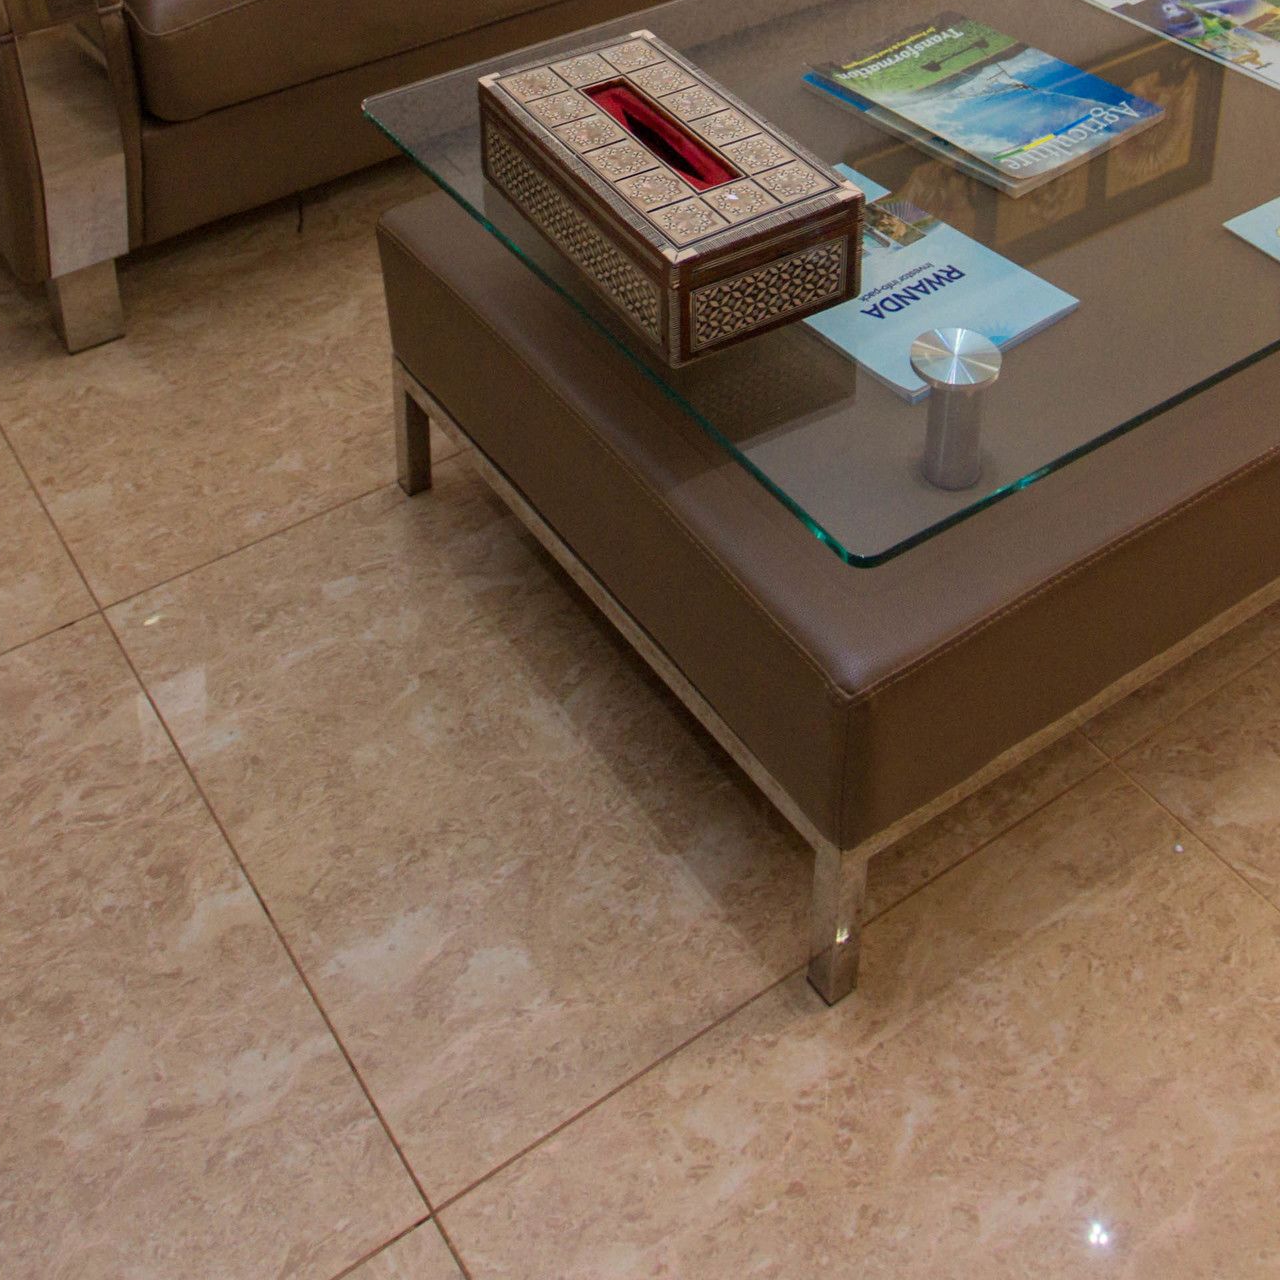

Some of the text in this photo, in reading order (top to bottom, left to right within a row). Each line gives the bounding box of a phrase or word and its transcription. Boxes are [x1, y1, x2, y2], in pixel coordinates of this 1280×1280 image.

[835, 27, 964, 80] Transformation
[1000, 100, 1140, 170] Agriculture
[860, 264, 966, 319] RWANDA
[861, 262, 935, 302] Investor info-pack
